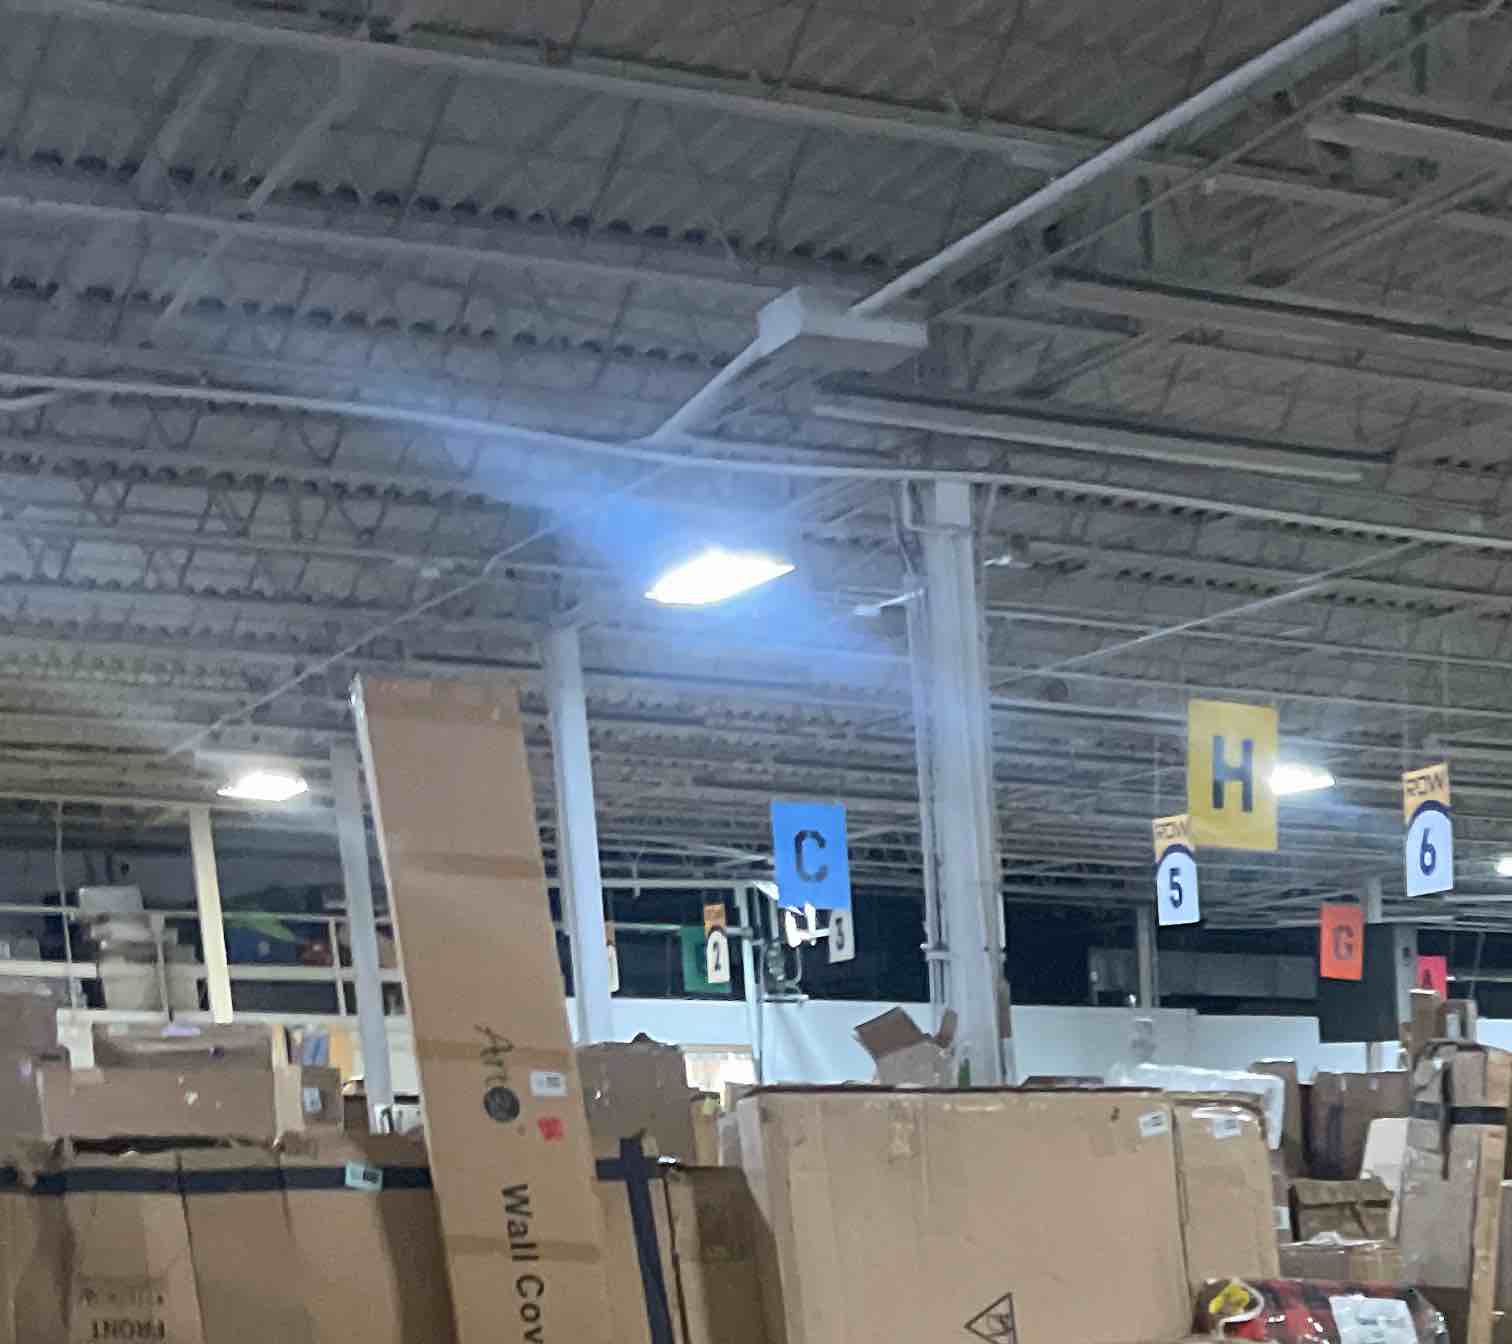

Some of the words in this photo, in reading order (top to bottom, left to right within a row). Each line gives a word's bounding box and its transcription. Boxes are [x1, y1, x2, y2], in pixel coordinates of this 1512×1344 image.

[1212, 735, 1254, 812] H
[1404, 773, 1445, 797] ROW
[794, 829, 828, 883] C
[1419, 828, 1437, 877] 6
[1169, 867, 1183, 909] 5
[836, 916, 845, 951] 3
[1331, 925, 1355, 960] G
[712, 940, 722, 971] 2
[501, 1183, 541, 1263] Wall
